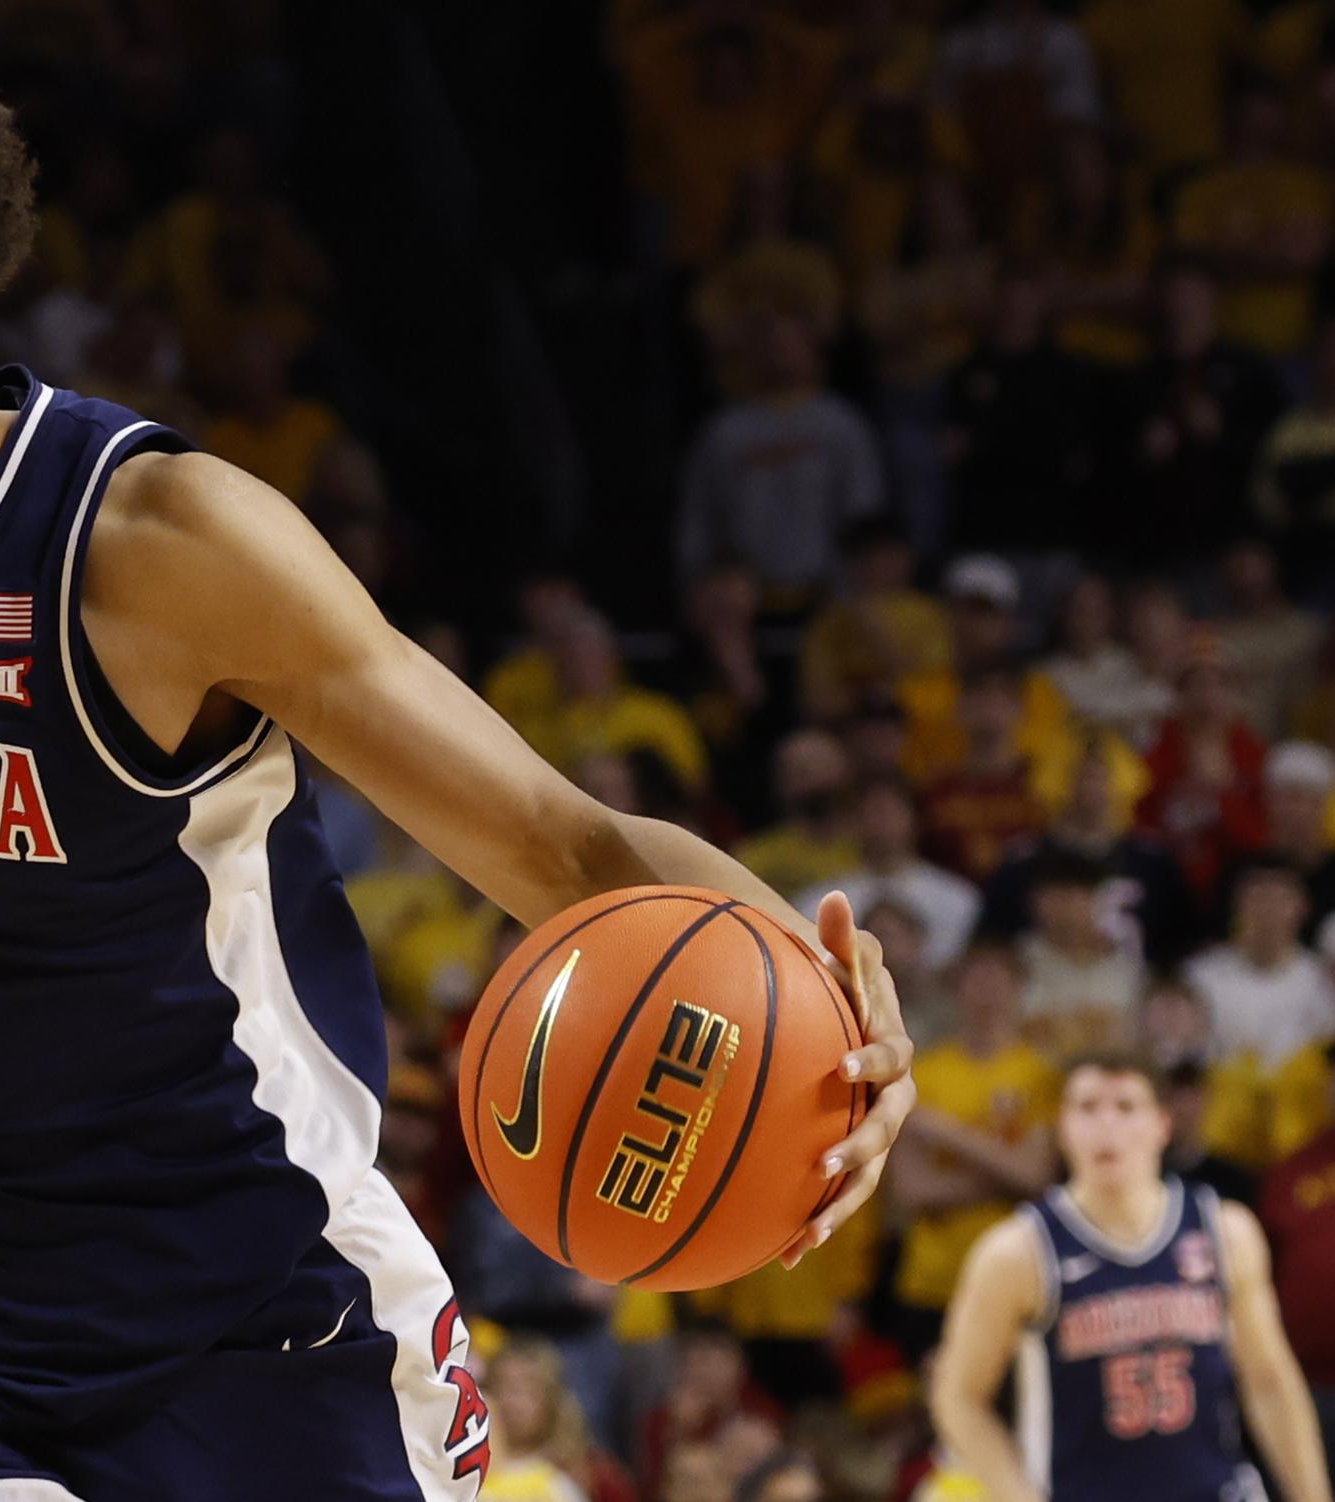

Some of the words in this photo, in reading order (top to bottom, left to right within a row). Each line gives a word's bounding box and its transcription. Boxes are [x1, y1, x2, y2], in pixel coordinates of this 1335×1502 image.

[597, 1000, 728, 1217] ELITE
[654, 1024, 741, 1223] CHAMPIONIP
[1102, 1348, 1196, 1438] 55
